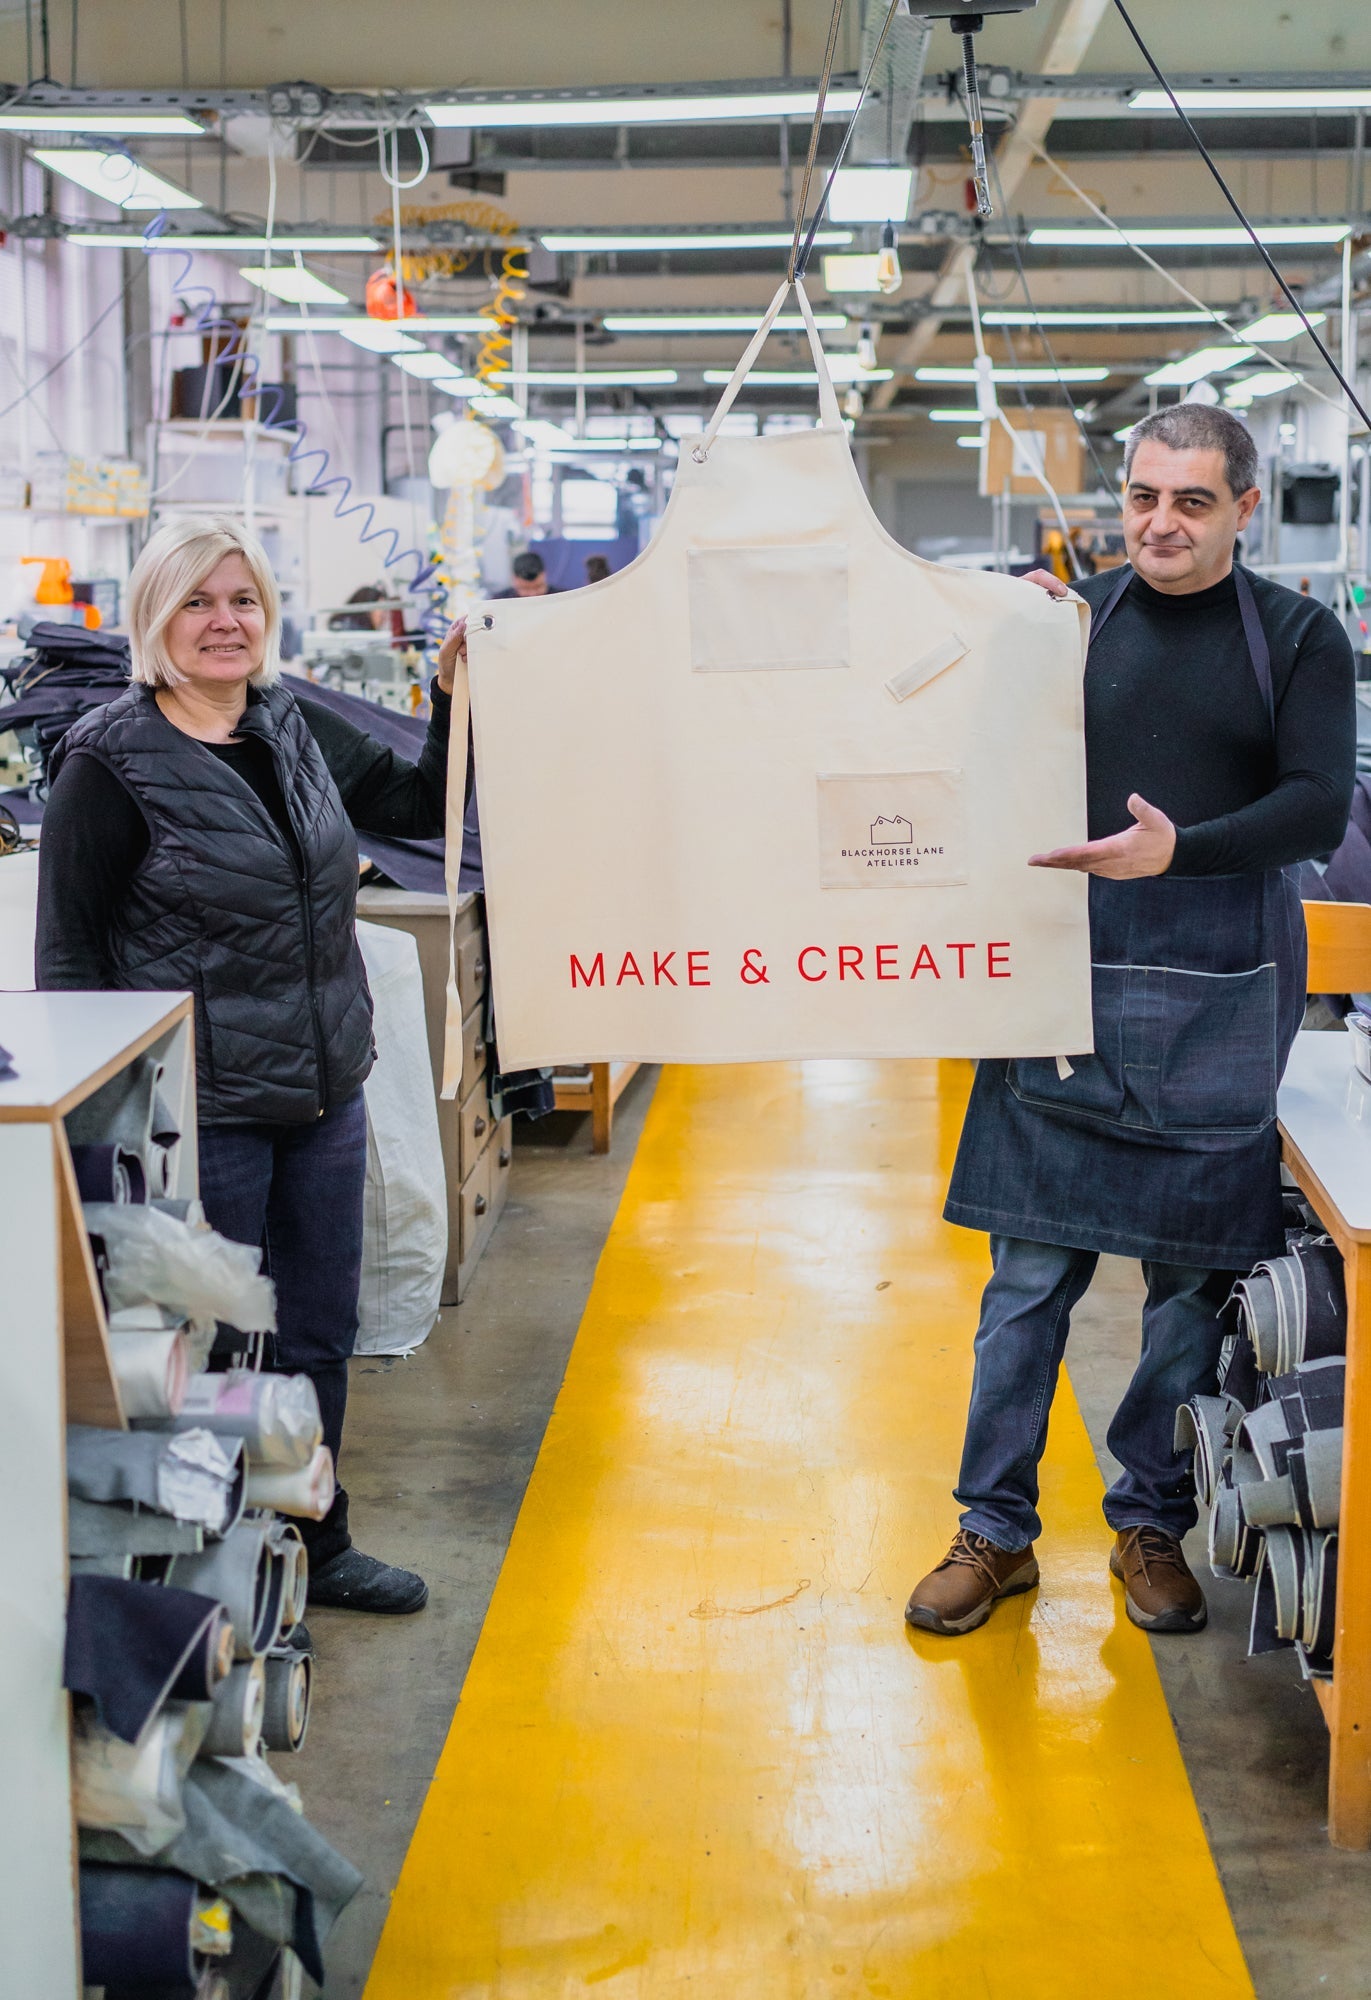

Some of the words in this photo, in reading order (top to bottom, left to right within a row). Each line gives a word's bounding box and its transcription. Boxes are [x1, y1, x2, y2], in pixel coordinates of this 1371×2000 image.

[841, 848, 911, 857] BLACKHORSE
[916, 847, 944, 855] LANE
[867, 858, 919, 867] ATELIERS
[570, 951, 711, 988] MAKE
[740, 949, 770, 984] &
[797, 942, 1011, 981] CREATE
